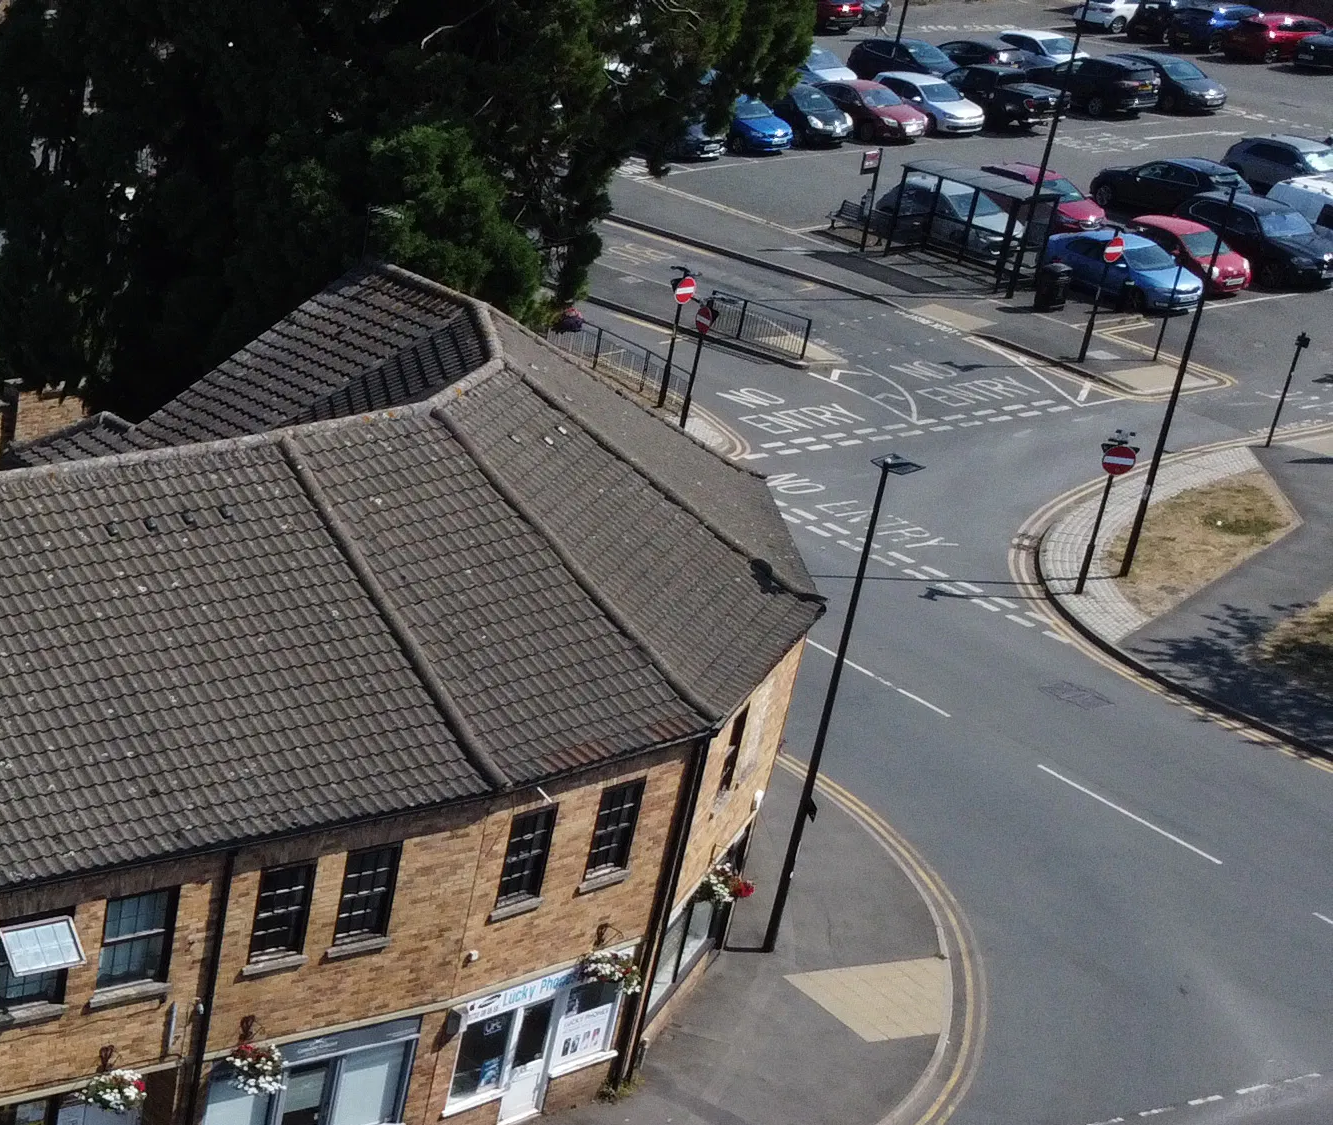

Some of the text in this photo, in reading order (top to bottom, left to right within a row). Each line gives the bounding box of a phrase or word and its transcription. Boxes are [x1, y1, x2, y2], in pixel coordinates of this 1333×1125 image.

[890, 361, 957, 381] NO
[716, 387, 785, 409] NO
[916, 376, 1040, 407] ENTRY
[739, 403, 866, 435] ENTRY
[766, 473, 826, 494] NO
[502, 985, 537, 1007] Lucky
